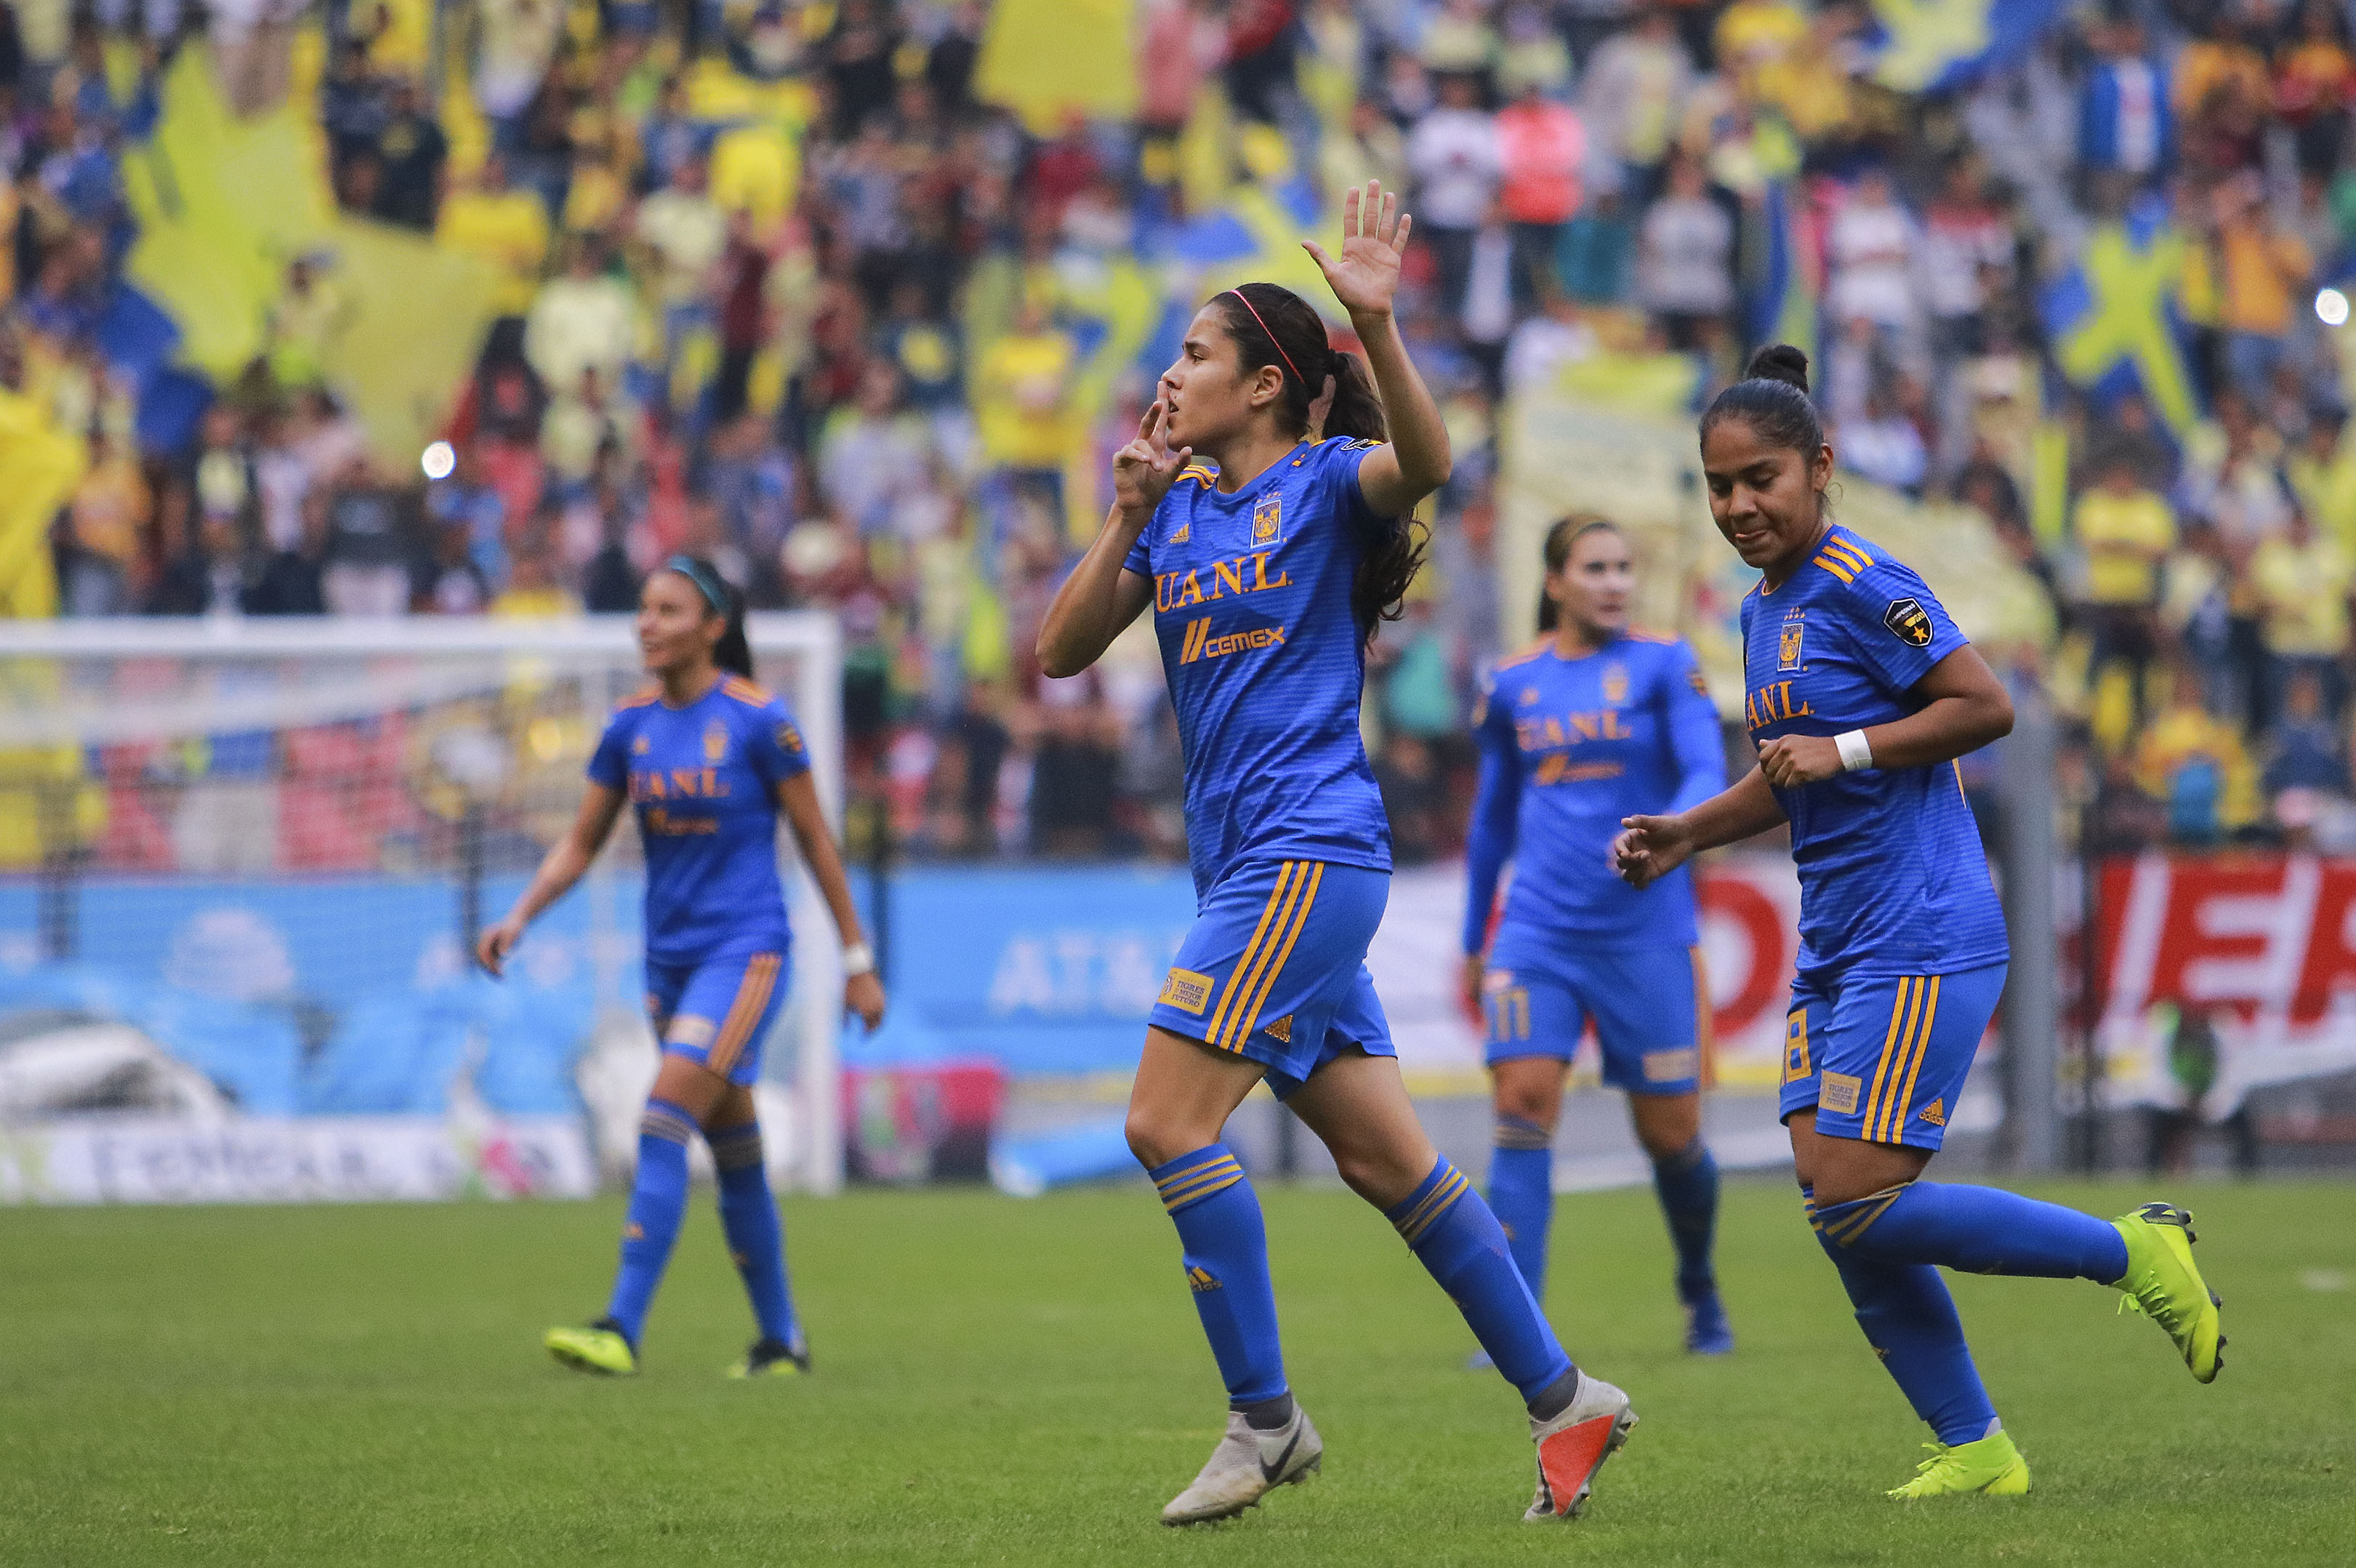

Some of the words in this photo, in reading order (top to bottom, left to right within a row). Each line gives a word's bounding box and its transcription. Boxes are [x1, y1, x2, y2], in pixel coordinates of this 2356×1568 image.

[1205, 626, 1286, 659] CEMEX
[1178, 981, 1205, 995] TIGRES
[1171, 994, 1200, 1008] FUTURO
[1785, 1008, 1812, 1084] 8
[1919, 1111, 1946, 1127] adidas
